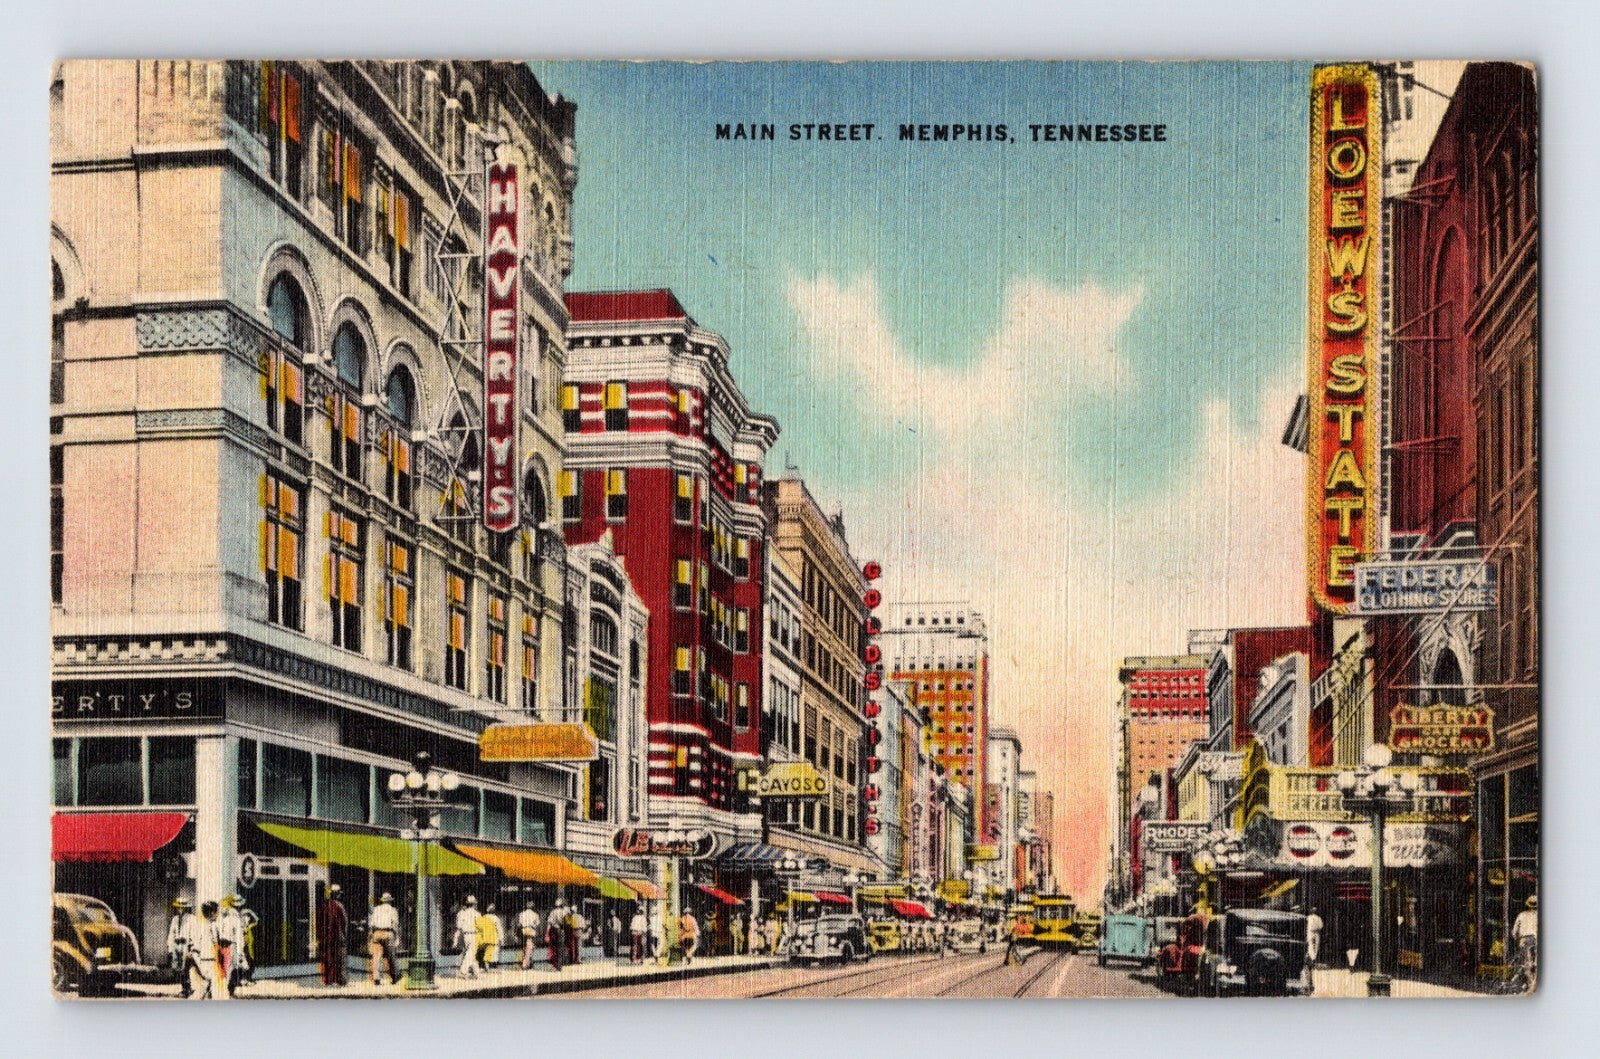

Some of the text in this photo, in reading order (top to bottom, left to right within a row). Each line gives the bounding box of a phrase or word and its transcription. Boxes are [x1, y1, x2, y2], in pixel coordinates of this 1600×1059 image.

[714, 123, 775, 141] MAIN
[898, 123, 1015, 144] MEMPHIS,
[1029, 123, 1167, 142] TENNESSEE
[1325, 354, 1367, 588] STATE
